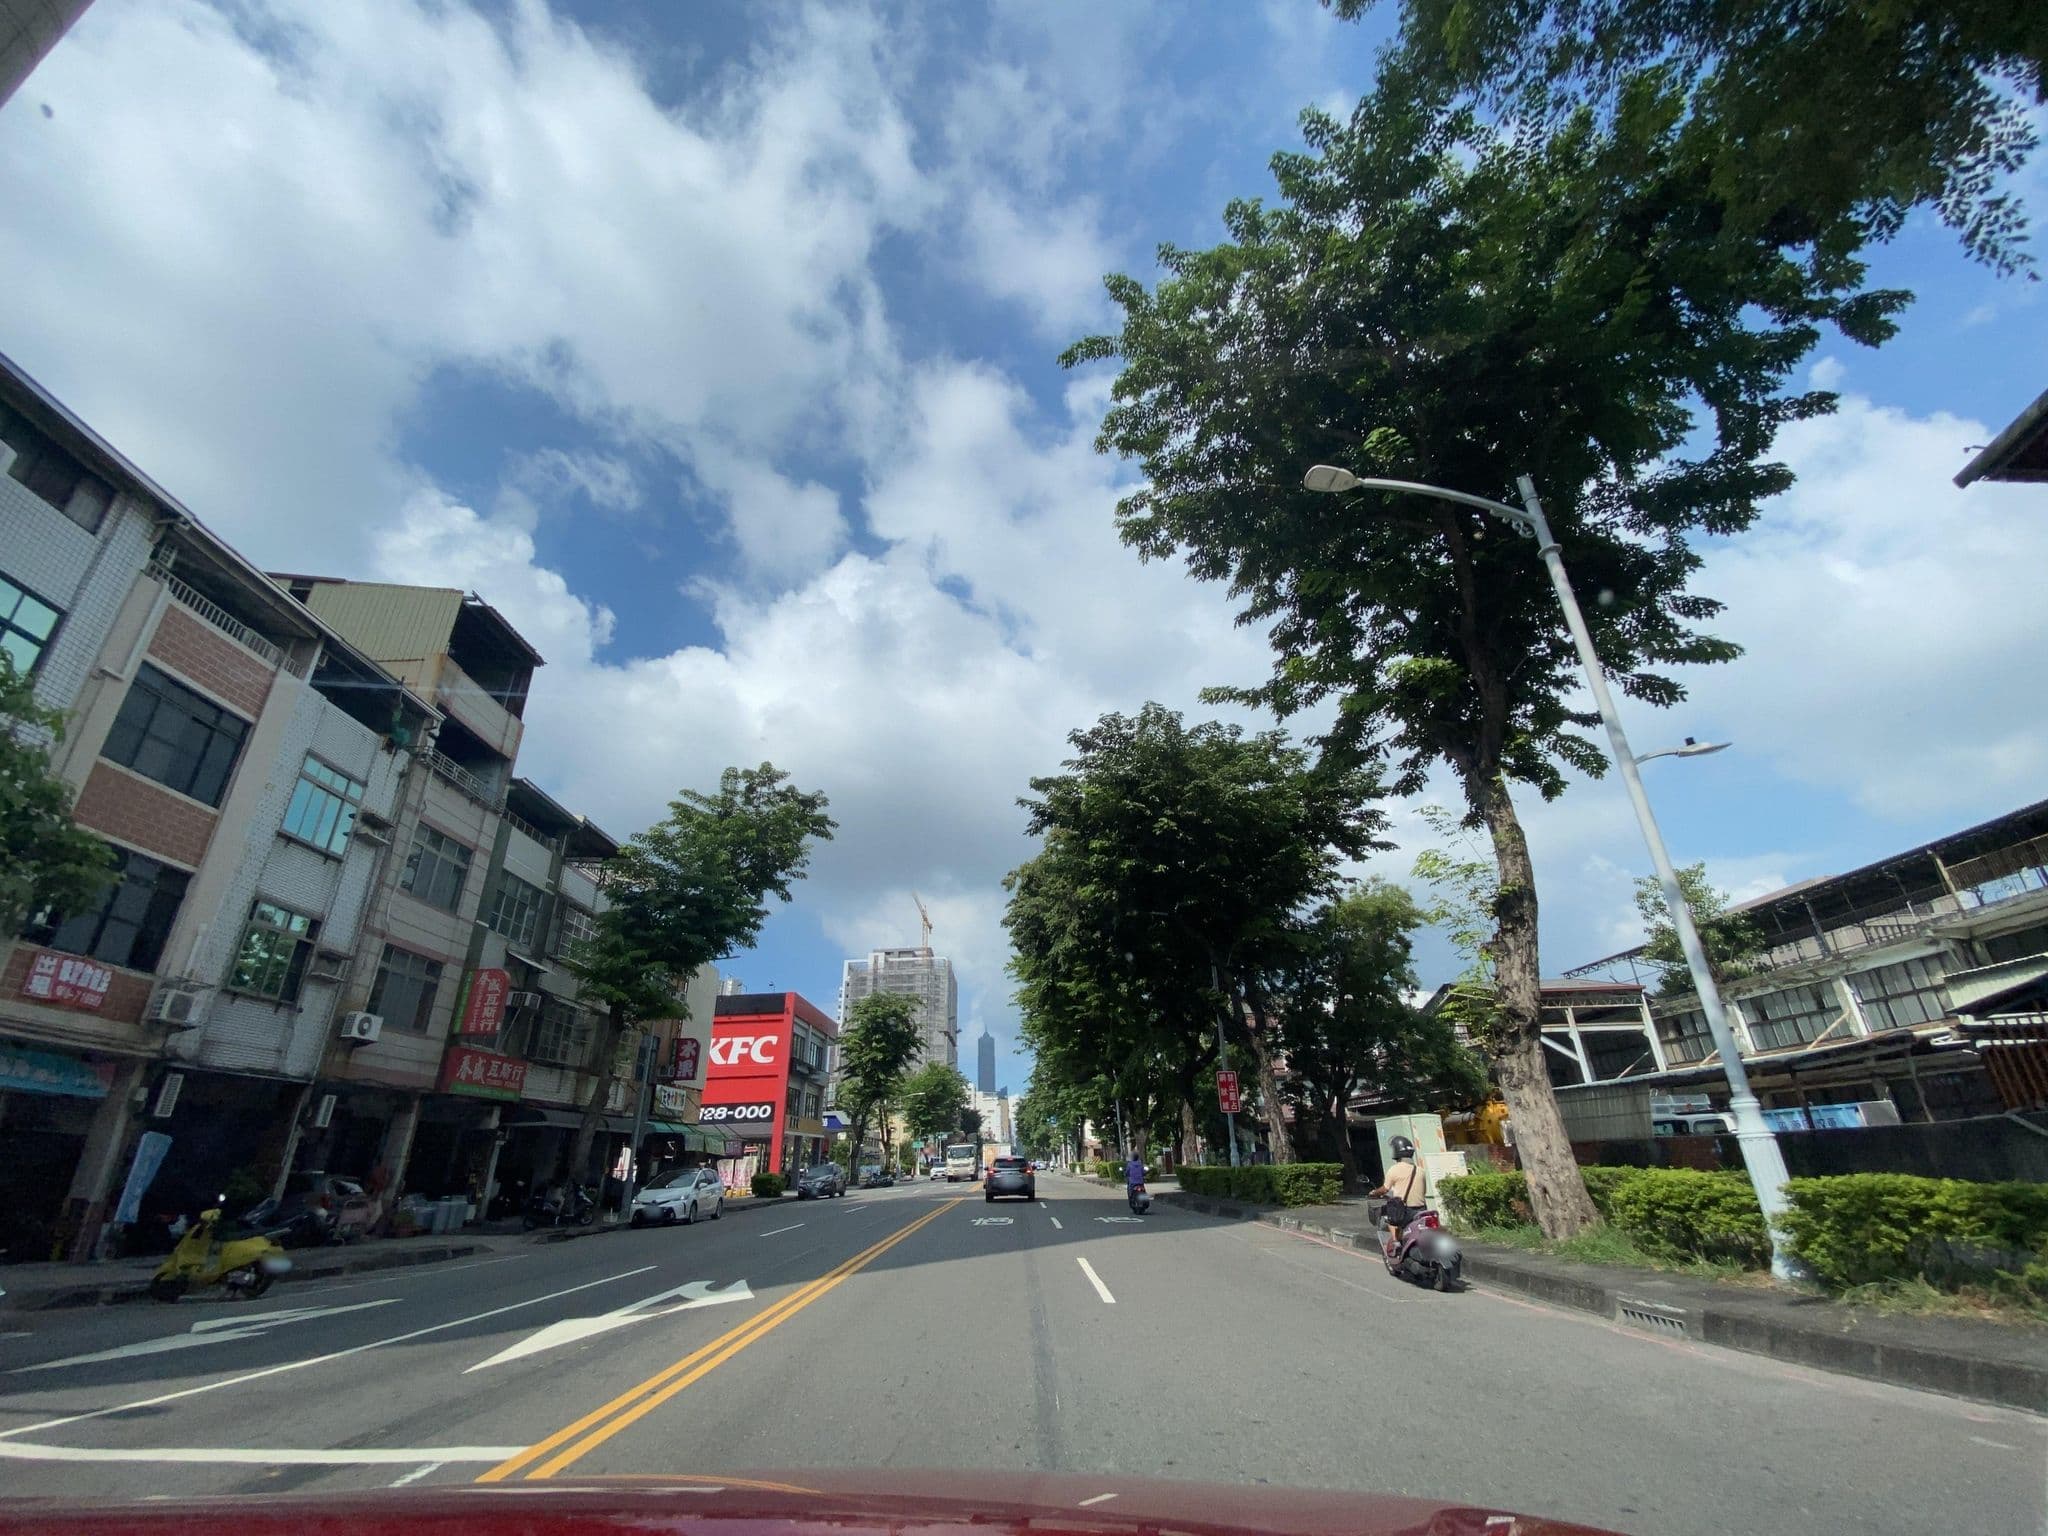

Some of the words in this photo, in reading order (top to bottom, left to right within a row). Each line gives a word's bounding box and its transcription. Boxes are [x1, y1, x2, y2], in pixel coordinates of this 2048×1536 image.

[676, 1041, 697, 1077] 水果
[709, 1036, 778, 1064] KFC
[699, 1105, 771, 1120] 128-000
